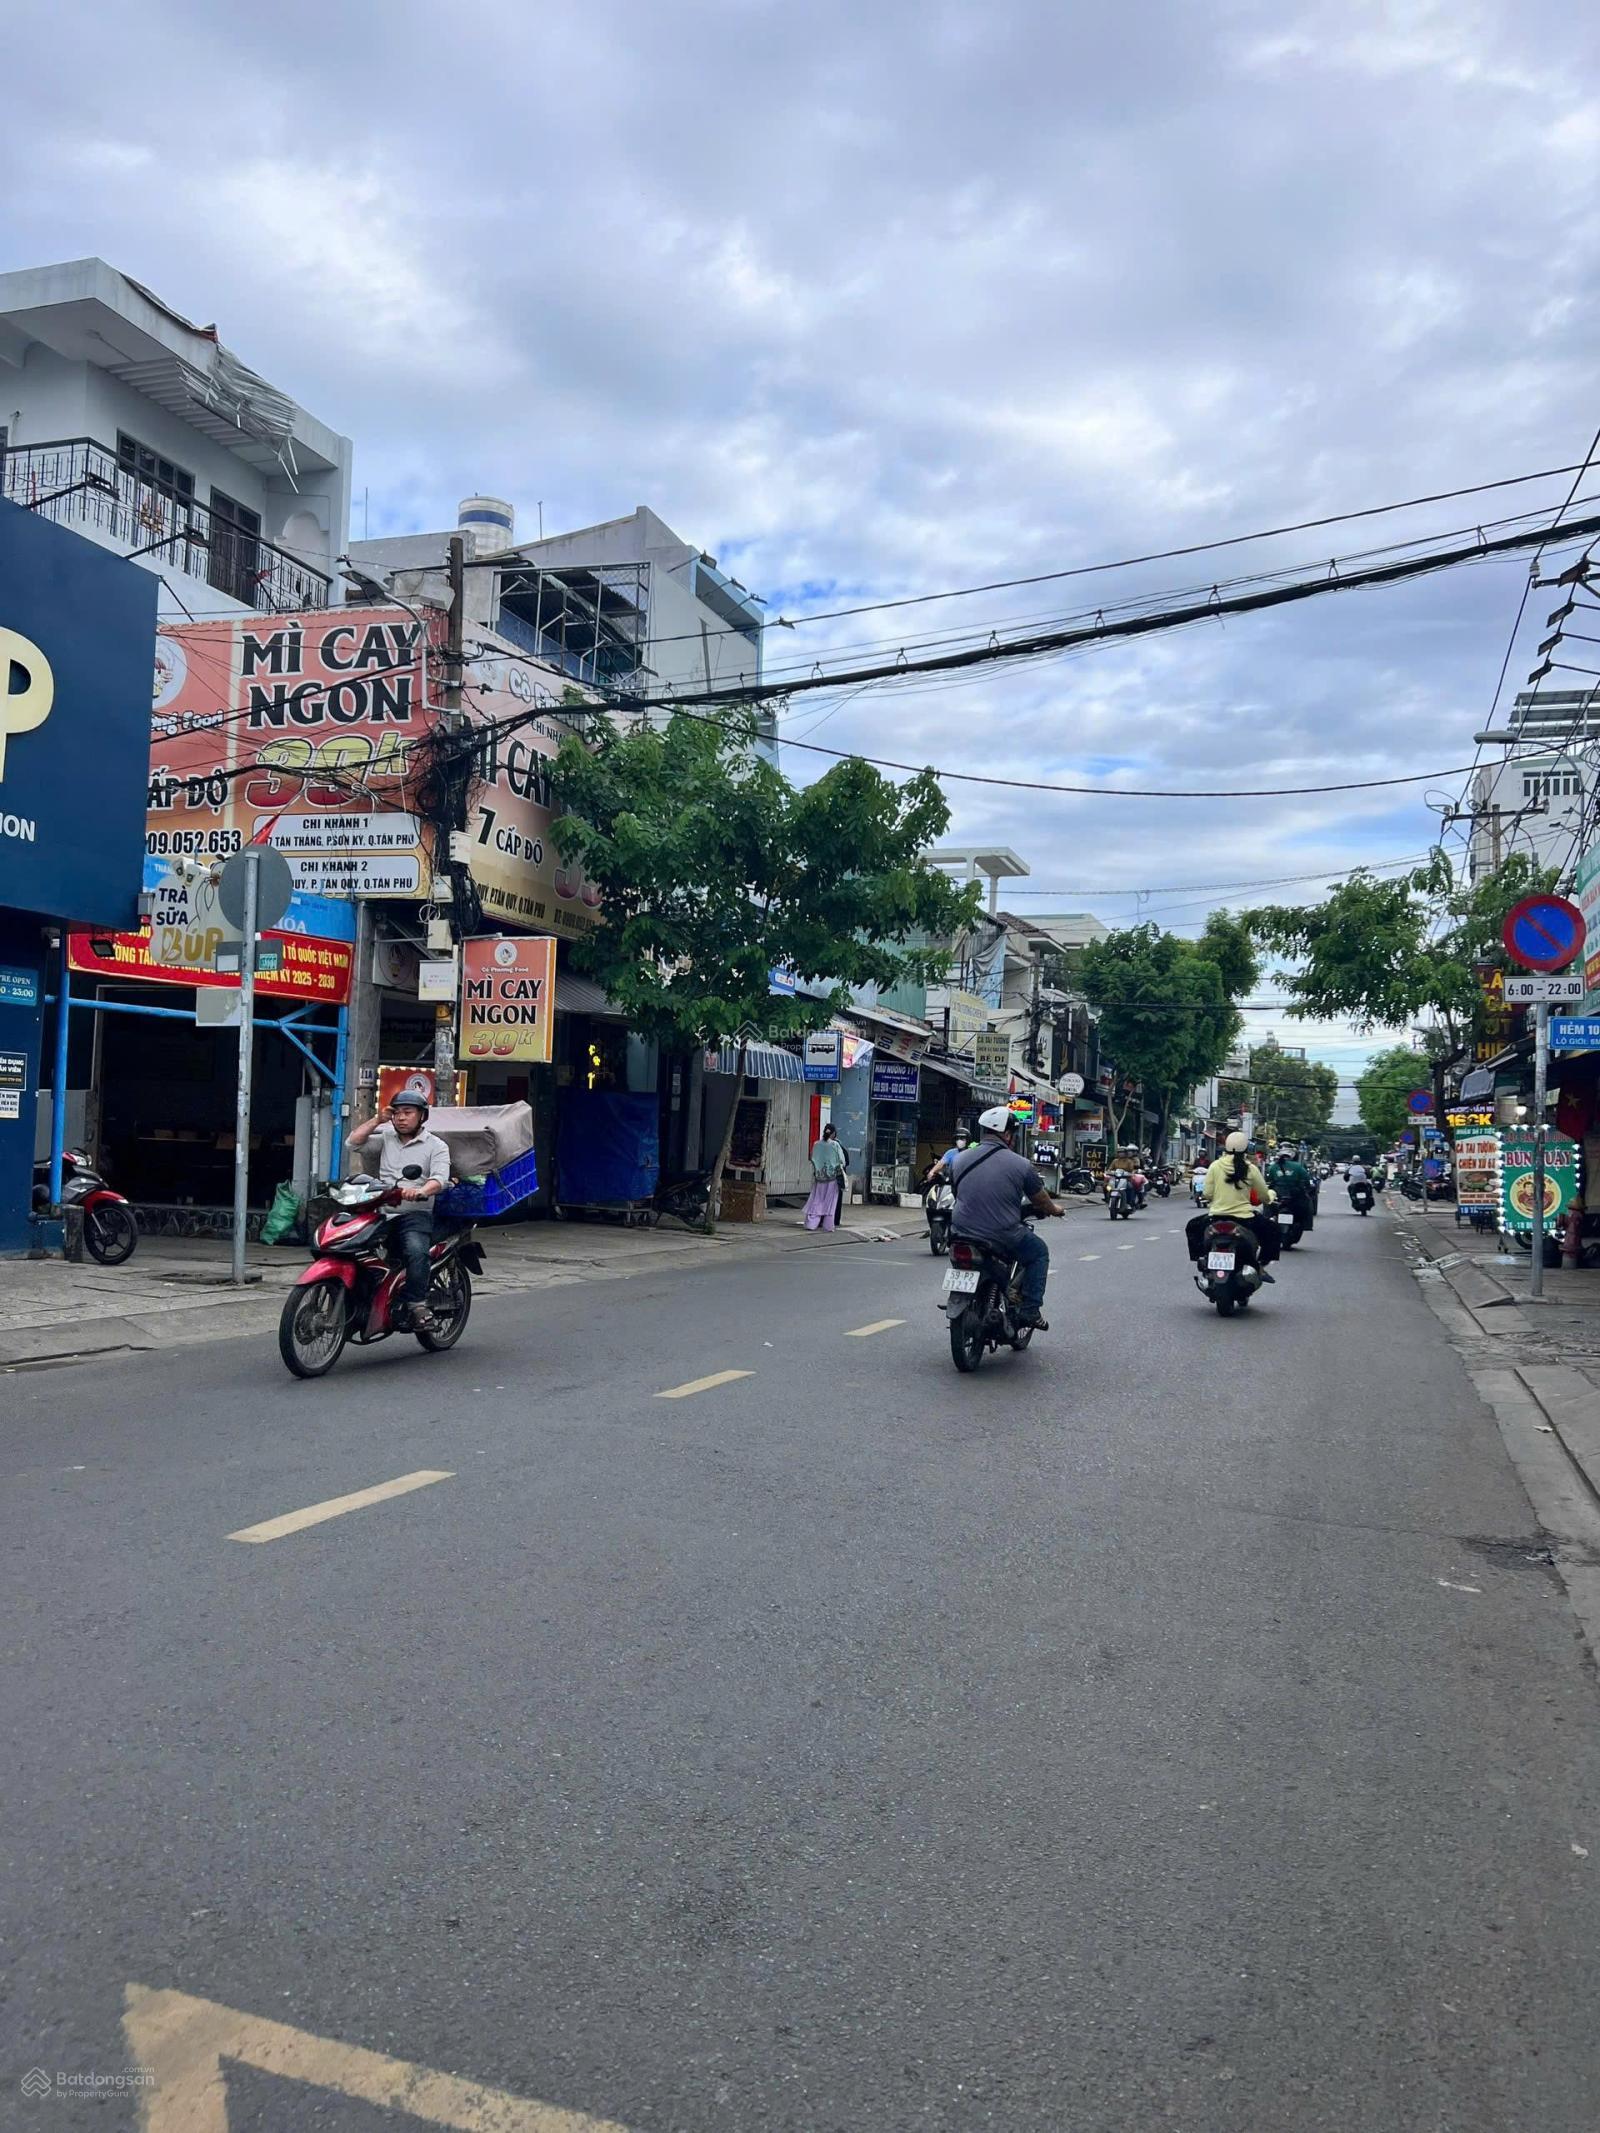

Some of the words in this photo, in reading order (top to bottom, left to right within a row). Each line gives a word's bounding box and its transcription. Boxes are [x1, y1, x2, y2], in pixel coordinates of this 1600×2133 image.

[240, 621, 303, 677] MÌ
[320, 622, 420, 675] CAY
[249, 678, 413, 728] NGON
[147, 766, 179, 810] ẤP
[303, 818, 320, 829] CHI
[362, 818, 368, 828] 1
[146, 829, 243, 855] 09.052.653
[478, 806, 496, 845] 7
[496, 827, 522, 856] CẤP
[524, 838, 543, 870] ĐỘ
[301, 861, 318, 872] CHI
[361, 861, 368, 871] 2
[159, 884, 188, 905] TRÀ
[156, 908, 188, 926] SỮA
[162, 926, 224, 962] BÚP
[298, 945, 317, 965] QUỐC
[319, 949, 332, 969] VIỆT
[292, 970, 312, 986] 2025
[318, 973, 335, 989] 2030
[466, 975, 493, 1000] MÌ
[500, 979, 543, 1000] CAY
[1508, 983, 1534, 996] 6:00
[1548, 982, 1581, 995] 22:00
[12, 987, 34, 998] 23:00
[469, 1004, 537, 1025] NGON
[1560, 1021, 1585, 1035] HẺM
[1505, 1146, 1533, 1167] BÚN
[1544, 1146, 1572, 1171] UẬY
